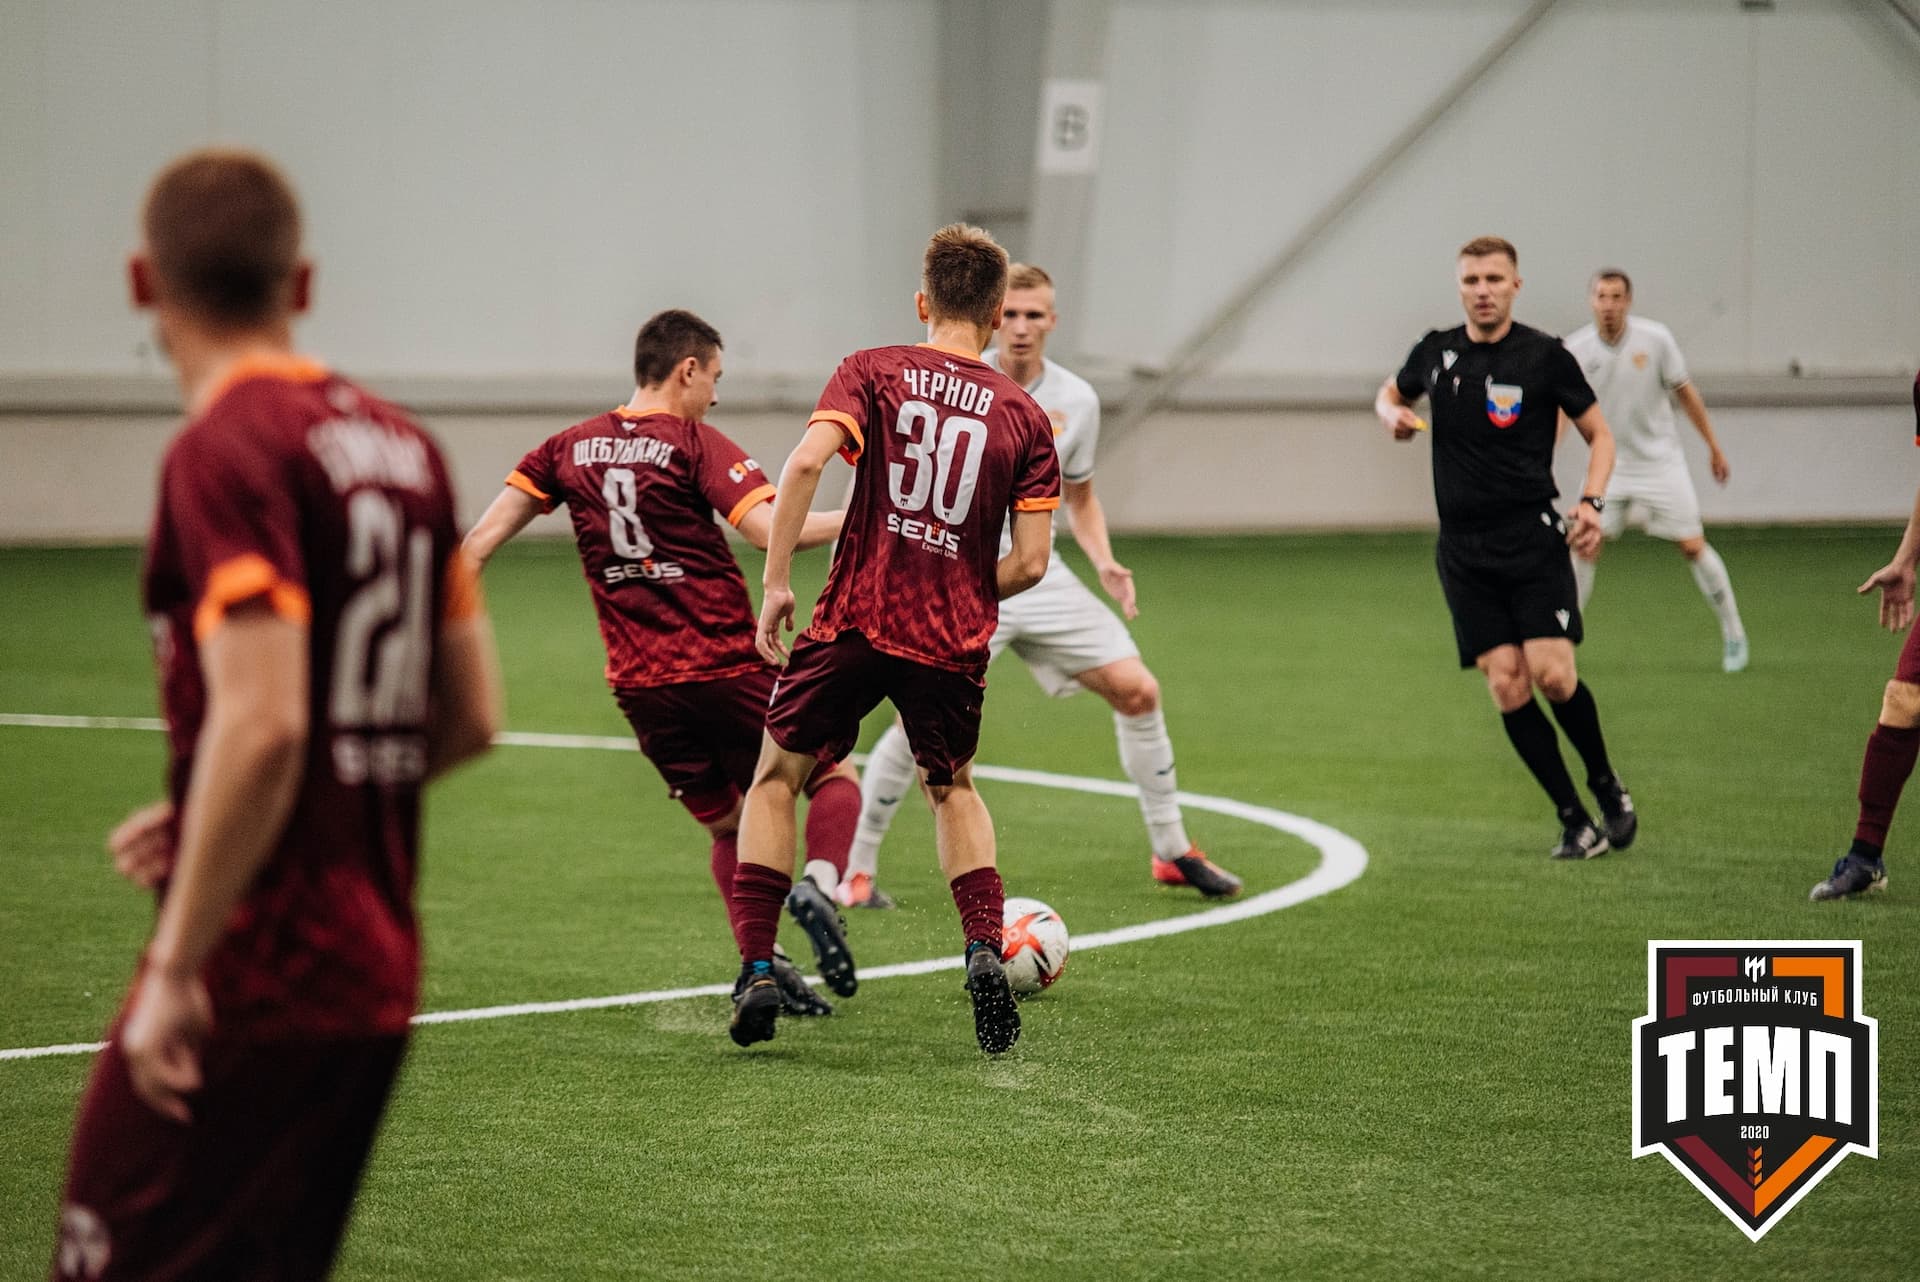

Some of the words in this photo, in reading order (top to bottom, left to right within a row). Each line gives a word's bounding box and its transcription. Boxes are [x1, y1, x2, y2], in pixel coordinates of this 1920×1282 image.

[903, 368, 995, 417] ЧЕРНОВ
[888, 400, 988, 526] 30
[602, 467, 654, 559] 8
